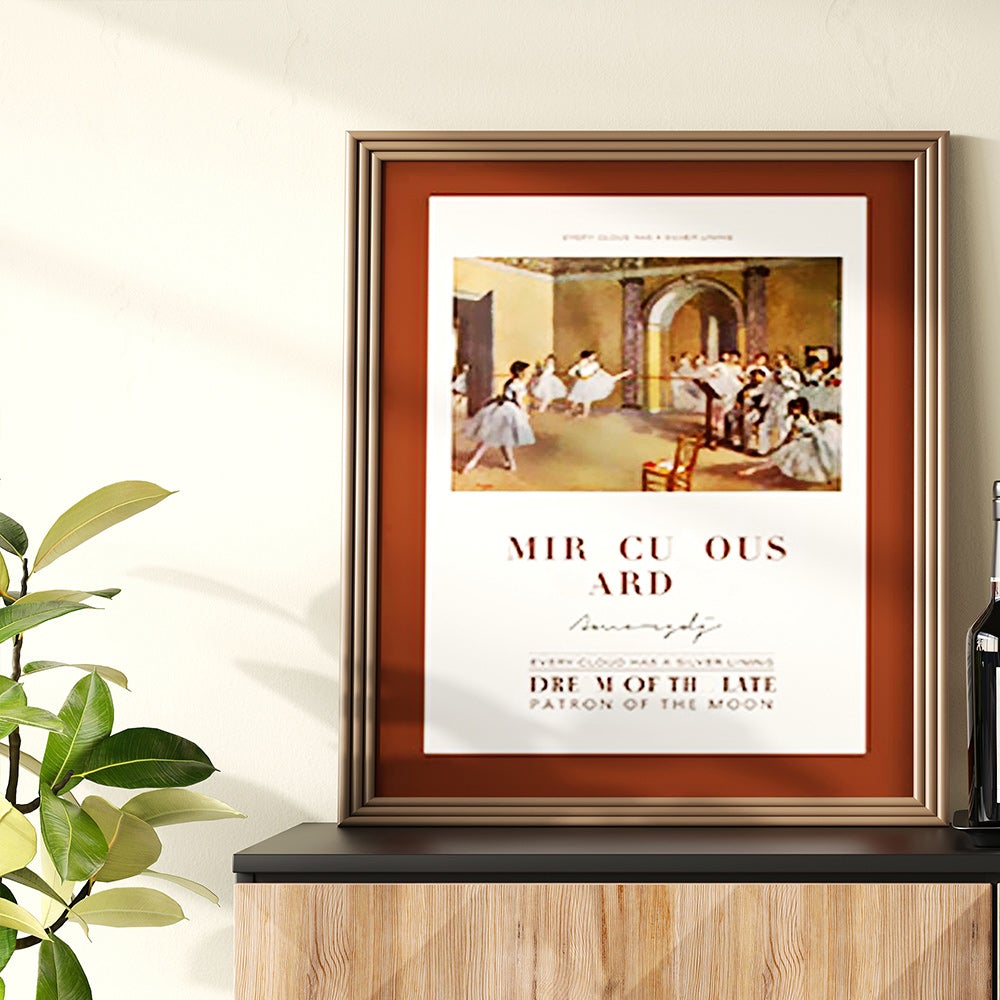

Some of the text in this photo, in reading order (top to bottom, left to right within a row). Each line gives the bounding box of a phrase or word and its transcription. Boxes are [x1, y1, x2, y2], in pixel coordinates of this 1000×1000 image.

[588, 570, 673, 596] ARD
[623, 676, 659, 693] OF
[530, 698, 773, 711] PATRON OF THE MOON
